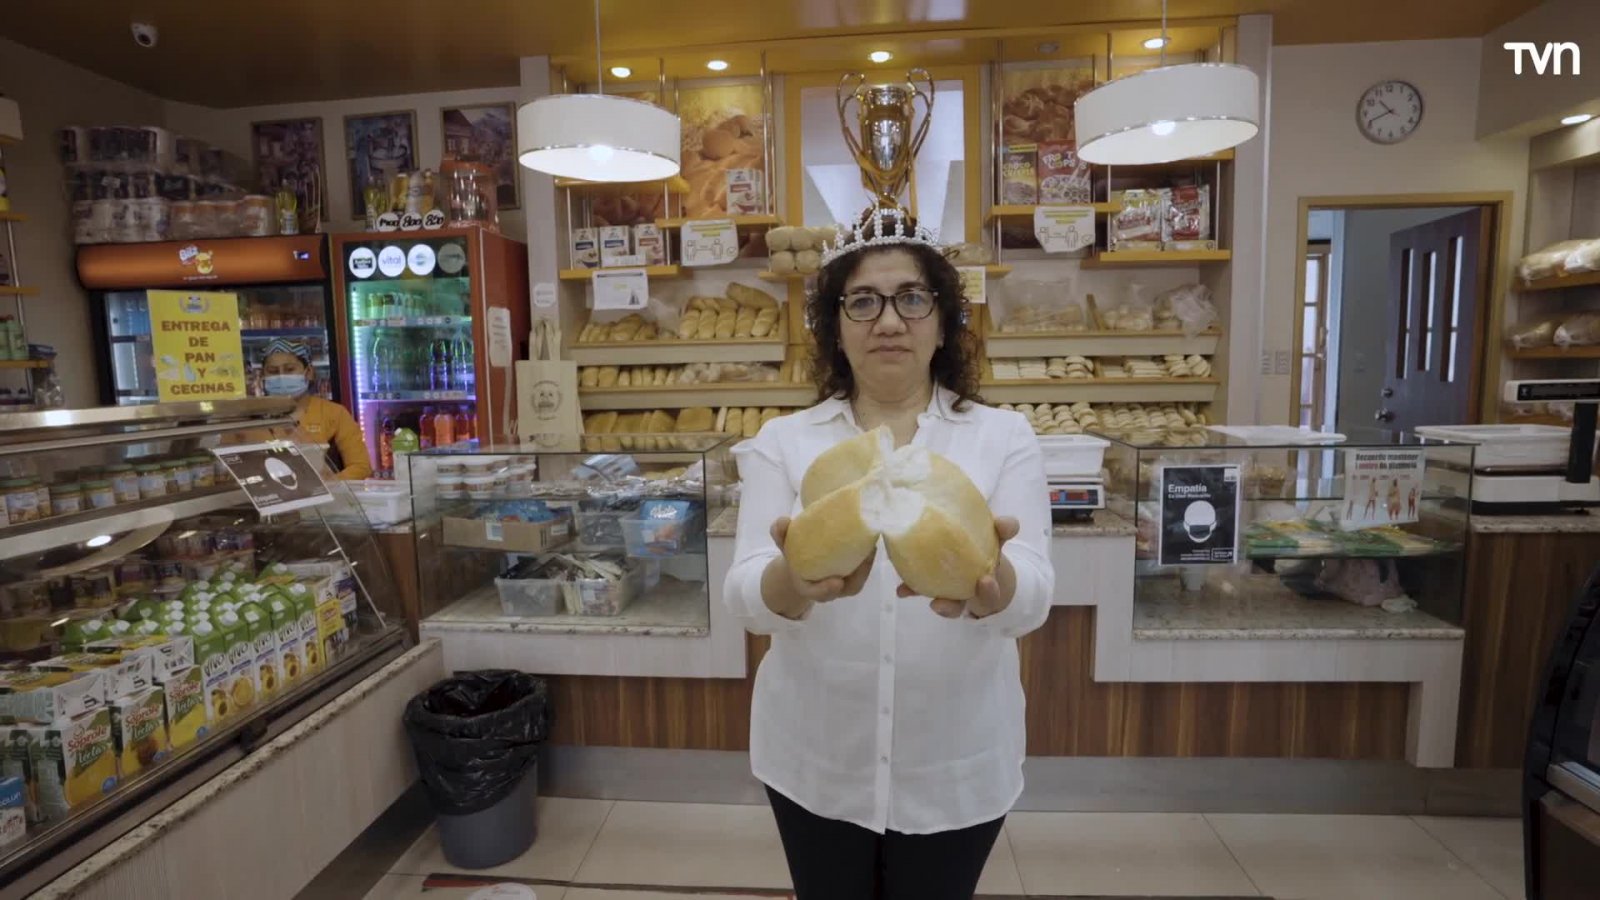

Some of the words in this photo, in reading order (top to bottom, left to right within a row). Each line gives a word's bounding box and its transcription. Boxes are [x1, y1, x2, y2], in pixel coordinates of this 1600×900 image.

[161, 321, 231, 332] ENTREGA
[188, 337, 209, 347] DE
[184, 352, 216, 363] PAN
[197, 368, 207, 378] Y
[170, 382, 235, 395] CECINAS
[1168, 483, 1207, 494] Empatía
[67, 727, 107, 752] Soprole
